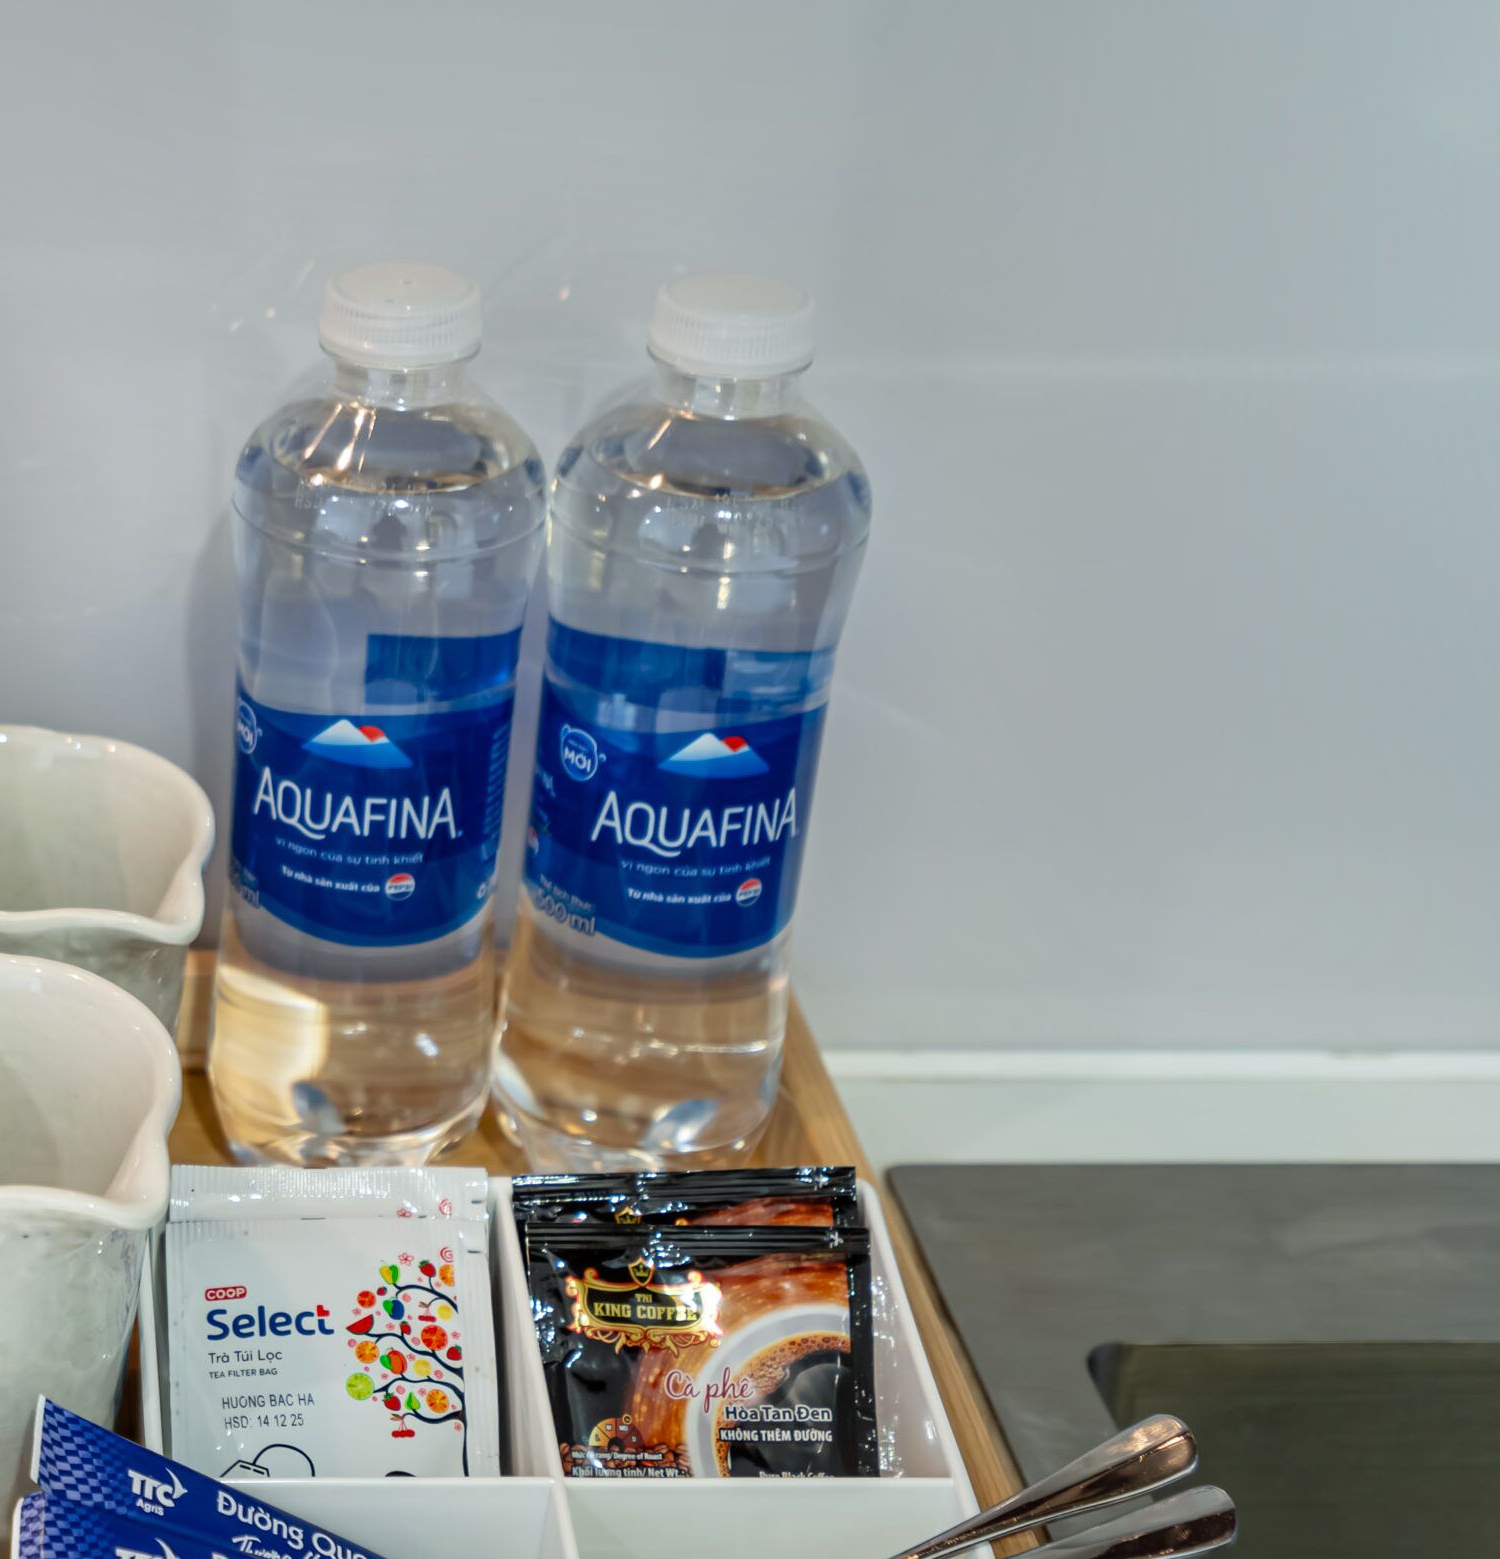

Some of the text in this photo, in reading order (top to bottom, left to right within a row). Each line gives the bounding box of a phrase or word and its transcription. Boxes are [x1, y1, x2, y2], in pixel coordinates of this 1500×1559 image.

[254, 766, 457, 840] AQUAFINA
[591, 787, 797, 857] AQUAFINA
[206, 1287, 246, 1300] COOP
[593, 1302, 632, 1318] KING
[206, 1304, 335, 1341] Select
[208, 1349, 283, 1364] Trà Túi Lọc
[209, 1367, 278, 1379] TEA FILTER BAG
[665, 1366, 755, 1414] Cà phê
[269, 1393, 294, 1407] BAC
[297, 1392, 316, 1407] HA
[724, 1405, 832, 1421] Hòa Tan Đen
[224, 1413, 305, 1430] HSD: 14 12 25
[720, 1427, 833, 1442] KHÔNG THÊM ĐƯỜNG
[648, 1467, 664, 1477] Net
[127, 1468, 176, 1507] TTC
[217, 1490, 304, 1550] Đường
